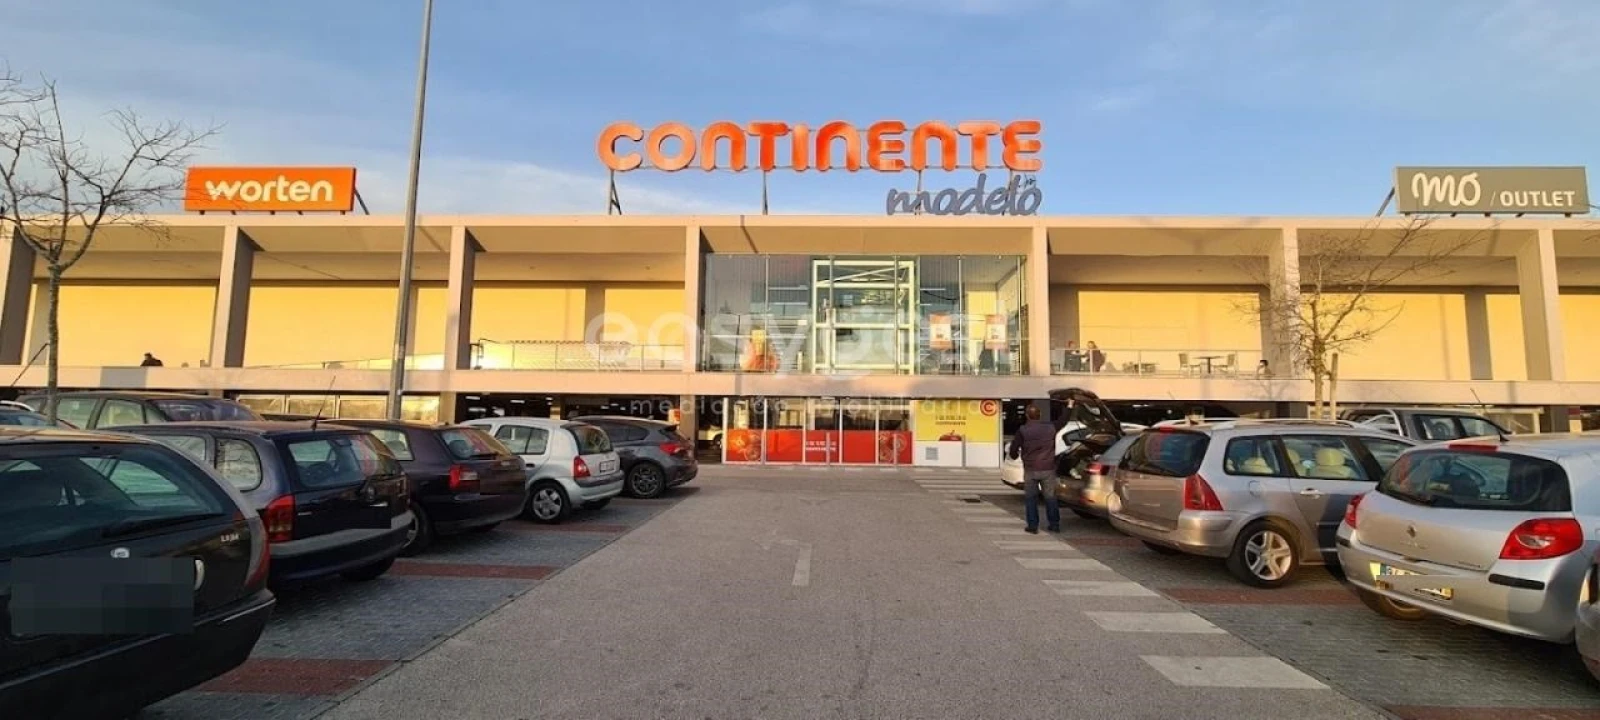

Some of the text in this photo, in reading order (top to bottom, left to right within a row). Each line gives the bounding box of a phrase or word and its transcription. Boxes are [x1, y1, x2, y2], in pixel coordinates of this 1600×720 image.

[598, 121, 1042, 171] CONTINENTE
[205, 175, 334, 202] worten
[886, 173, 1042, 216] modelo
[1500, 191, 1575, 206] OUTLET
